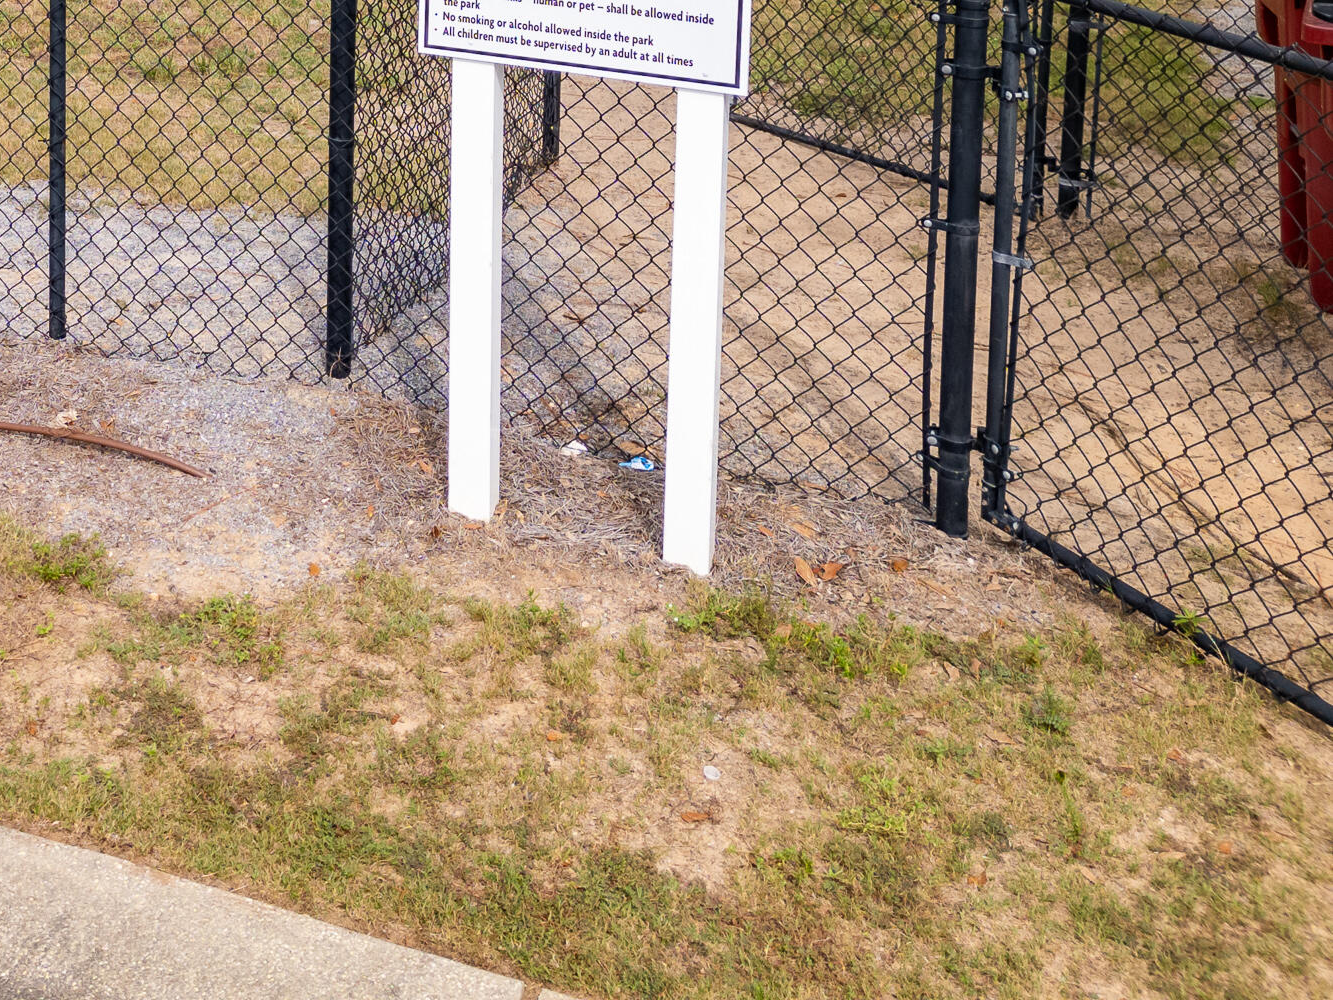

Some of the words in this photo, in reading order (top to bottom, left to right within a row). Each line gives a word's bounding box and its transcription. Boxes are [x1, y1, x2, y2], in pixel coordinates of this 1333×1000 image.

[460, 0, 480, 10] park
[579, 2, 595, 12] pet
[606, 2, 628, 15] shall
[631, 5, 642, 17] be
[644, 7, 683, 21] allowed
[685, 12, 714, 25] inside
[443, 11, 456, 22] No
[458, 14, 495, 30] smoking
[509, 19, 542, 32] alcohol
[545, 23, 582, 37] allowed
[584, 29, 611, 41] inside
[614, 31, 630, 43] the
[632, 35, 654, 47] park
[442, 26, 455, 37] All
[457, 28, 494, 41] children
[496, 35, 518, 45] must
[520, 35, 531, 47] be
[534, 40, 583, 53] supervised
[585, 43, 597, 57] by
[599, 48, 610, 56] an
[612, 47, 638, 60] adult
[640, 53, 650, 61] at
[652, 52, 664, 63] all
[666, 55, 693, 67] times
